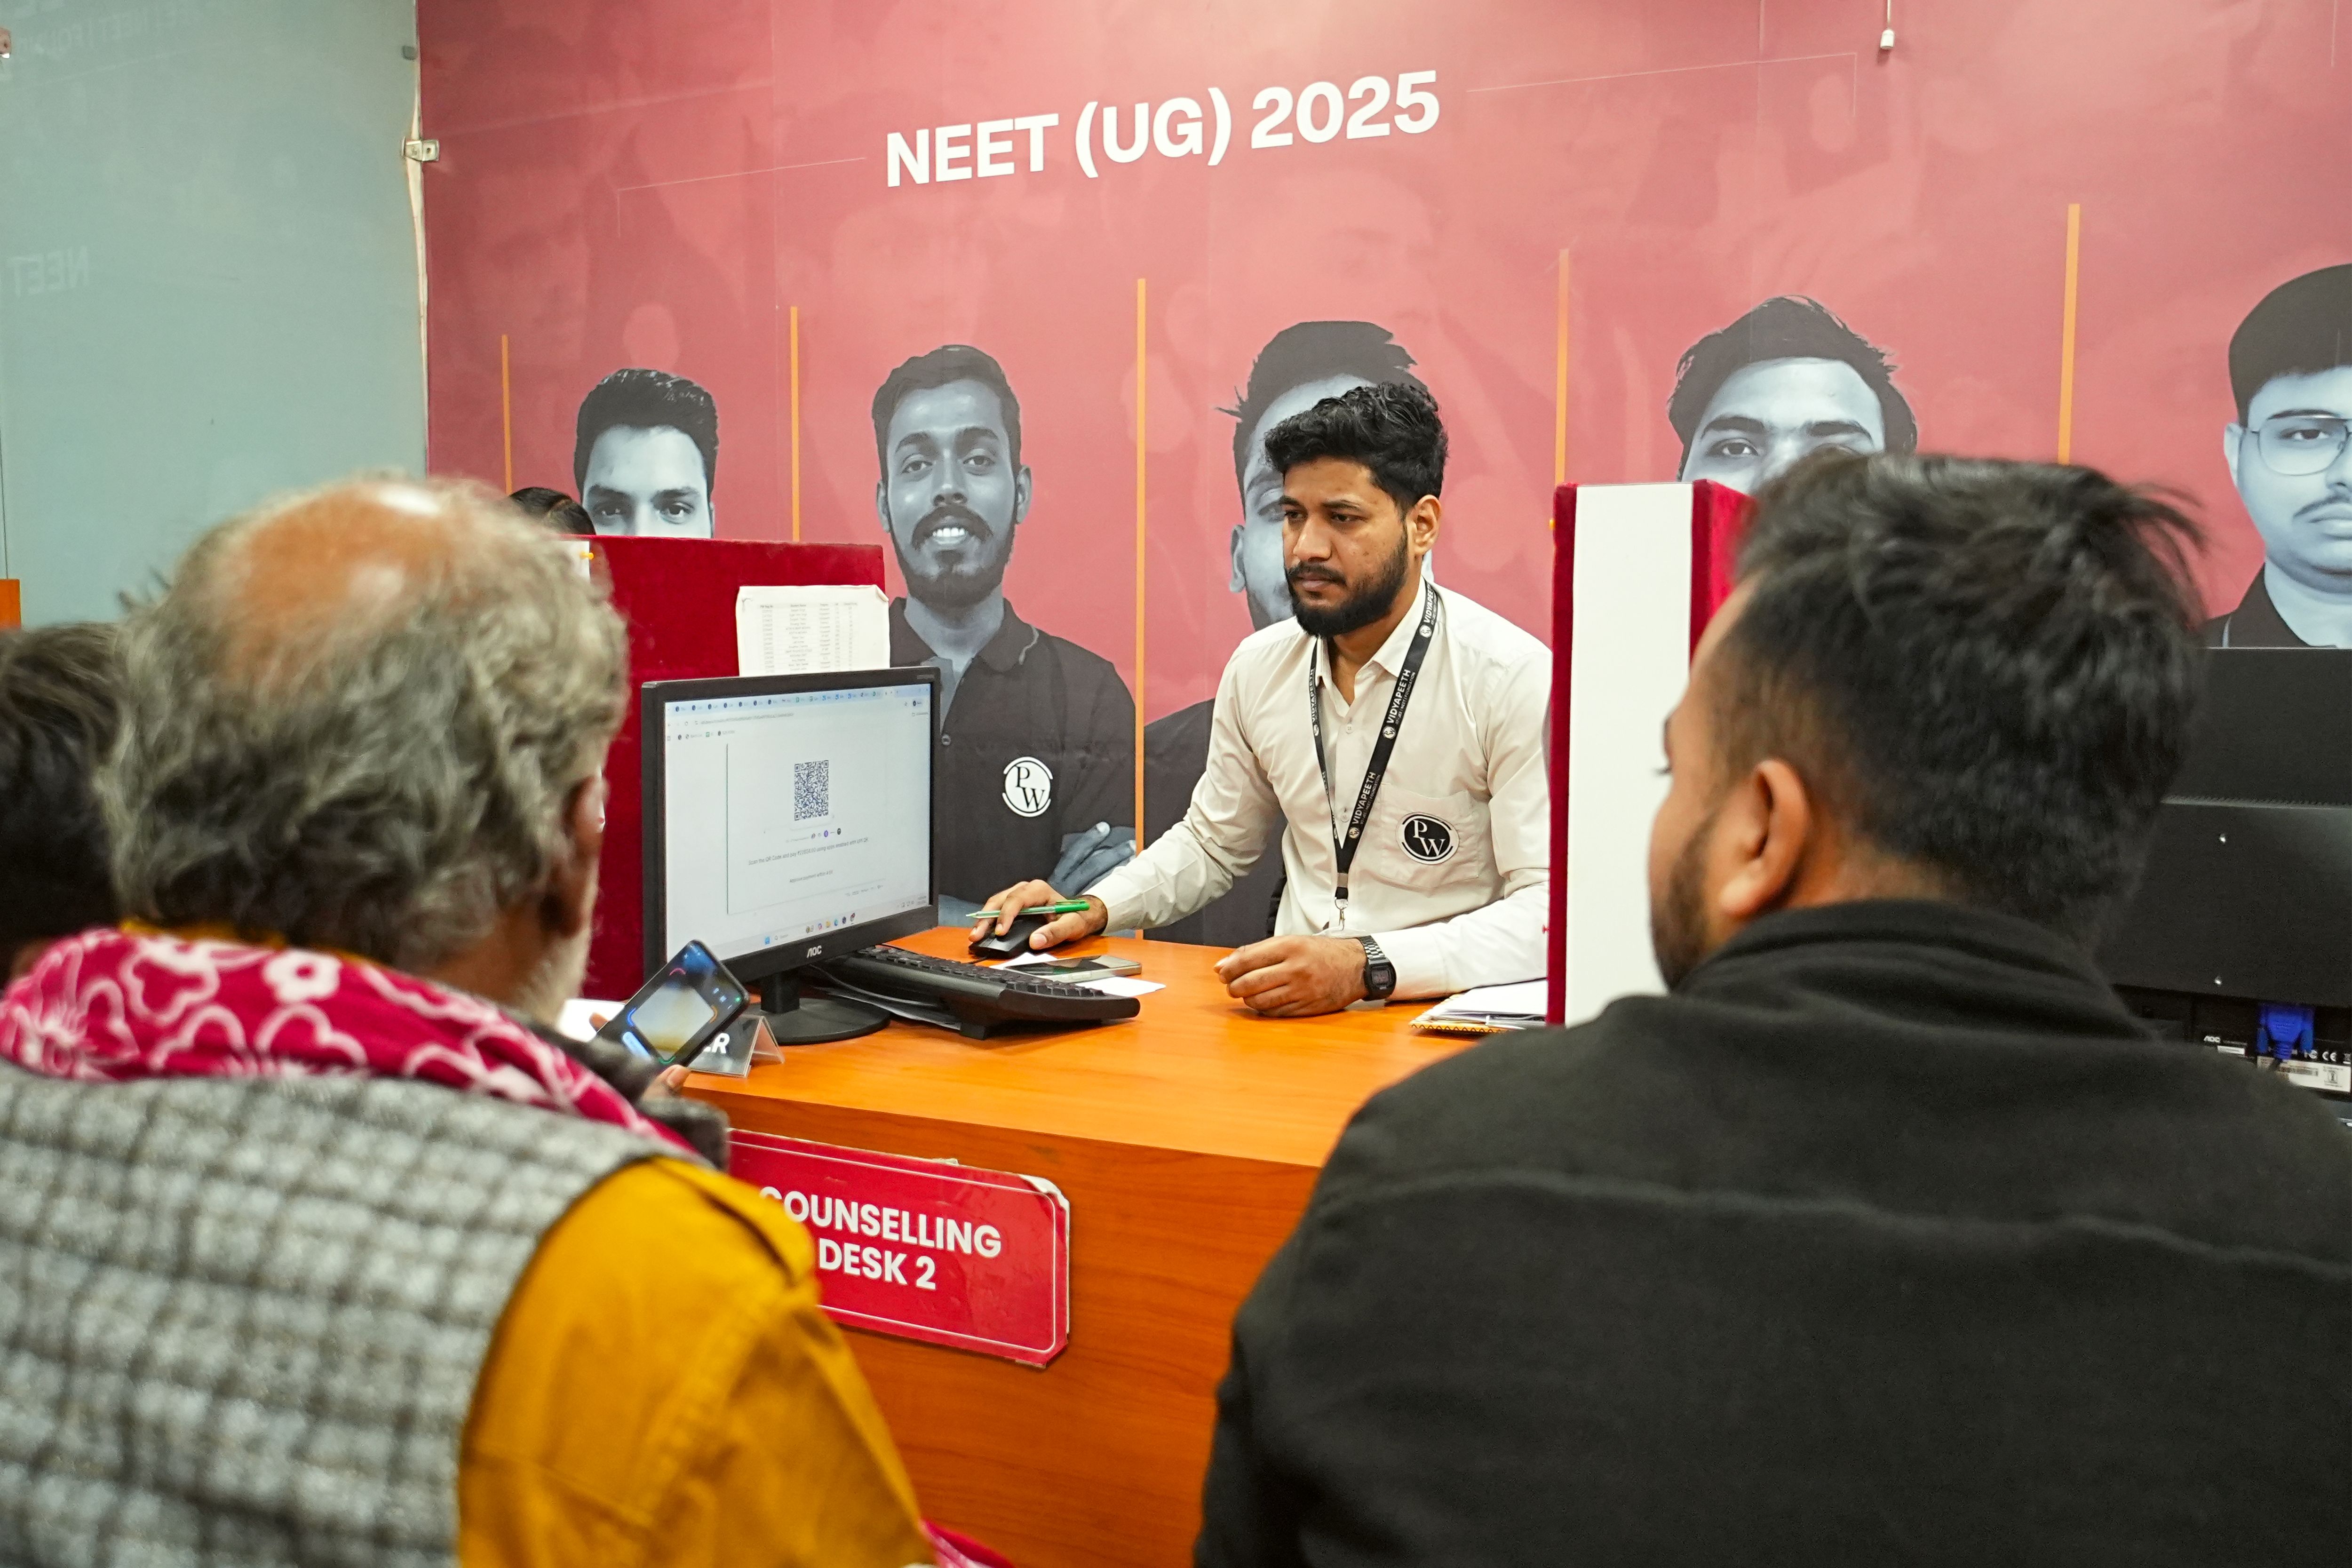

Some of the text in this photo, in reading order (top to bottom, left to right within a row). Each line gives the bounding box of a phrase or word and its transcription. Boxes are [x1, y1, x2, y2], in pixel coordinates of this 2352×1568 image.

[887, 70, 1440, 187] NEET (UG) 2025
[1387, 669, 1411, 724] VIDYAPEETH
[1015, 766, 1046, 811] PW
[1352, 772, 1376, 824] VIDYAPEETH
[1412, 819, 1446, 857] PW
[806, 945, 822, 958] AOC
[818, 1237, 936, 1290] DESK 2
